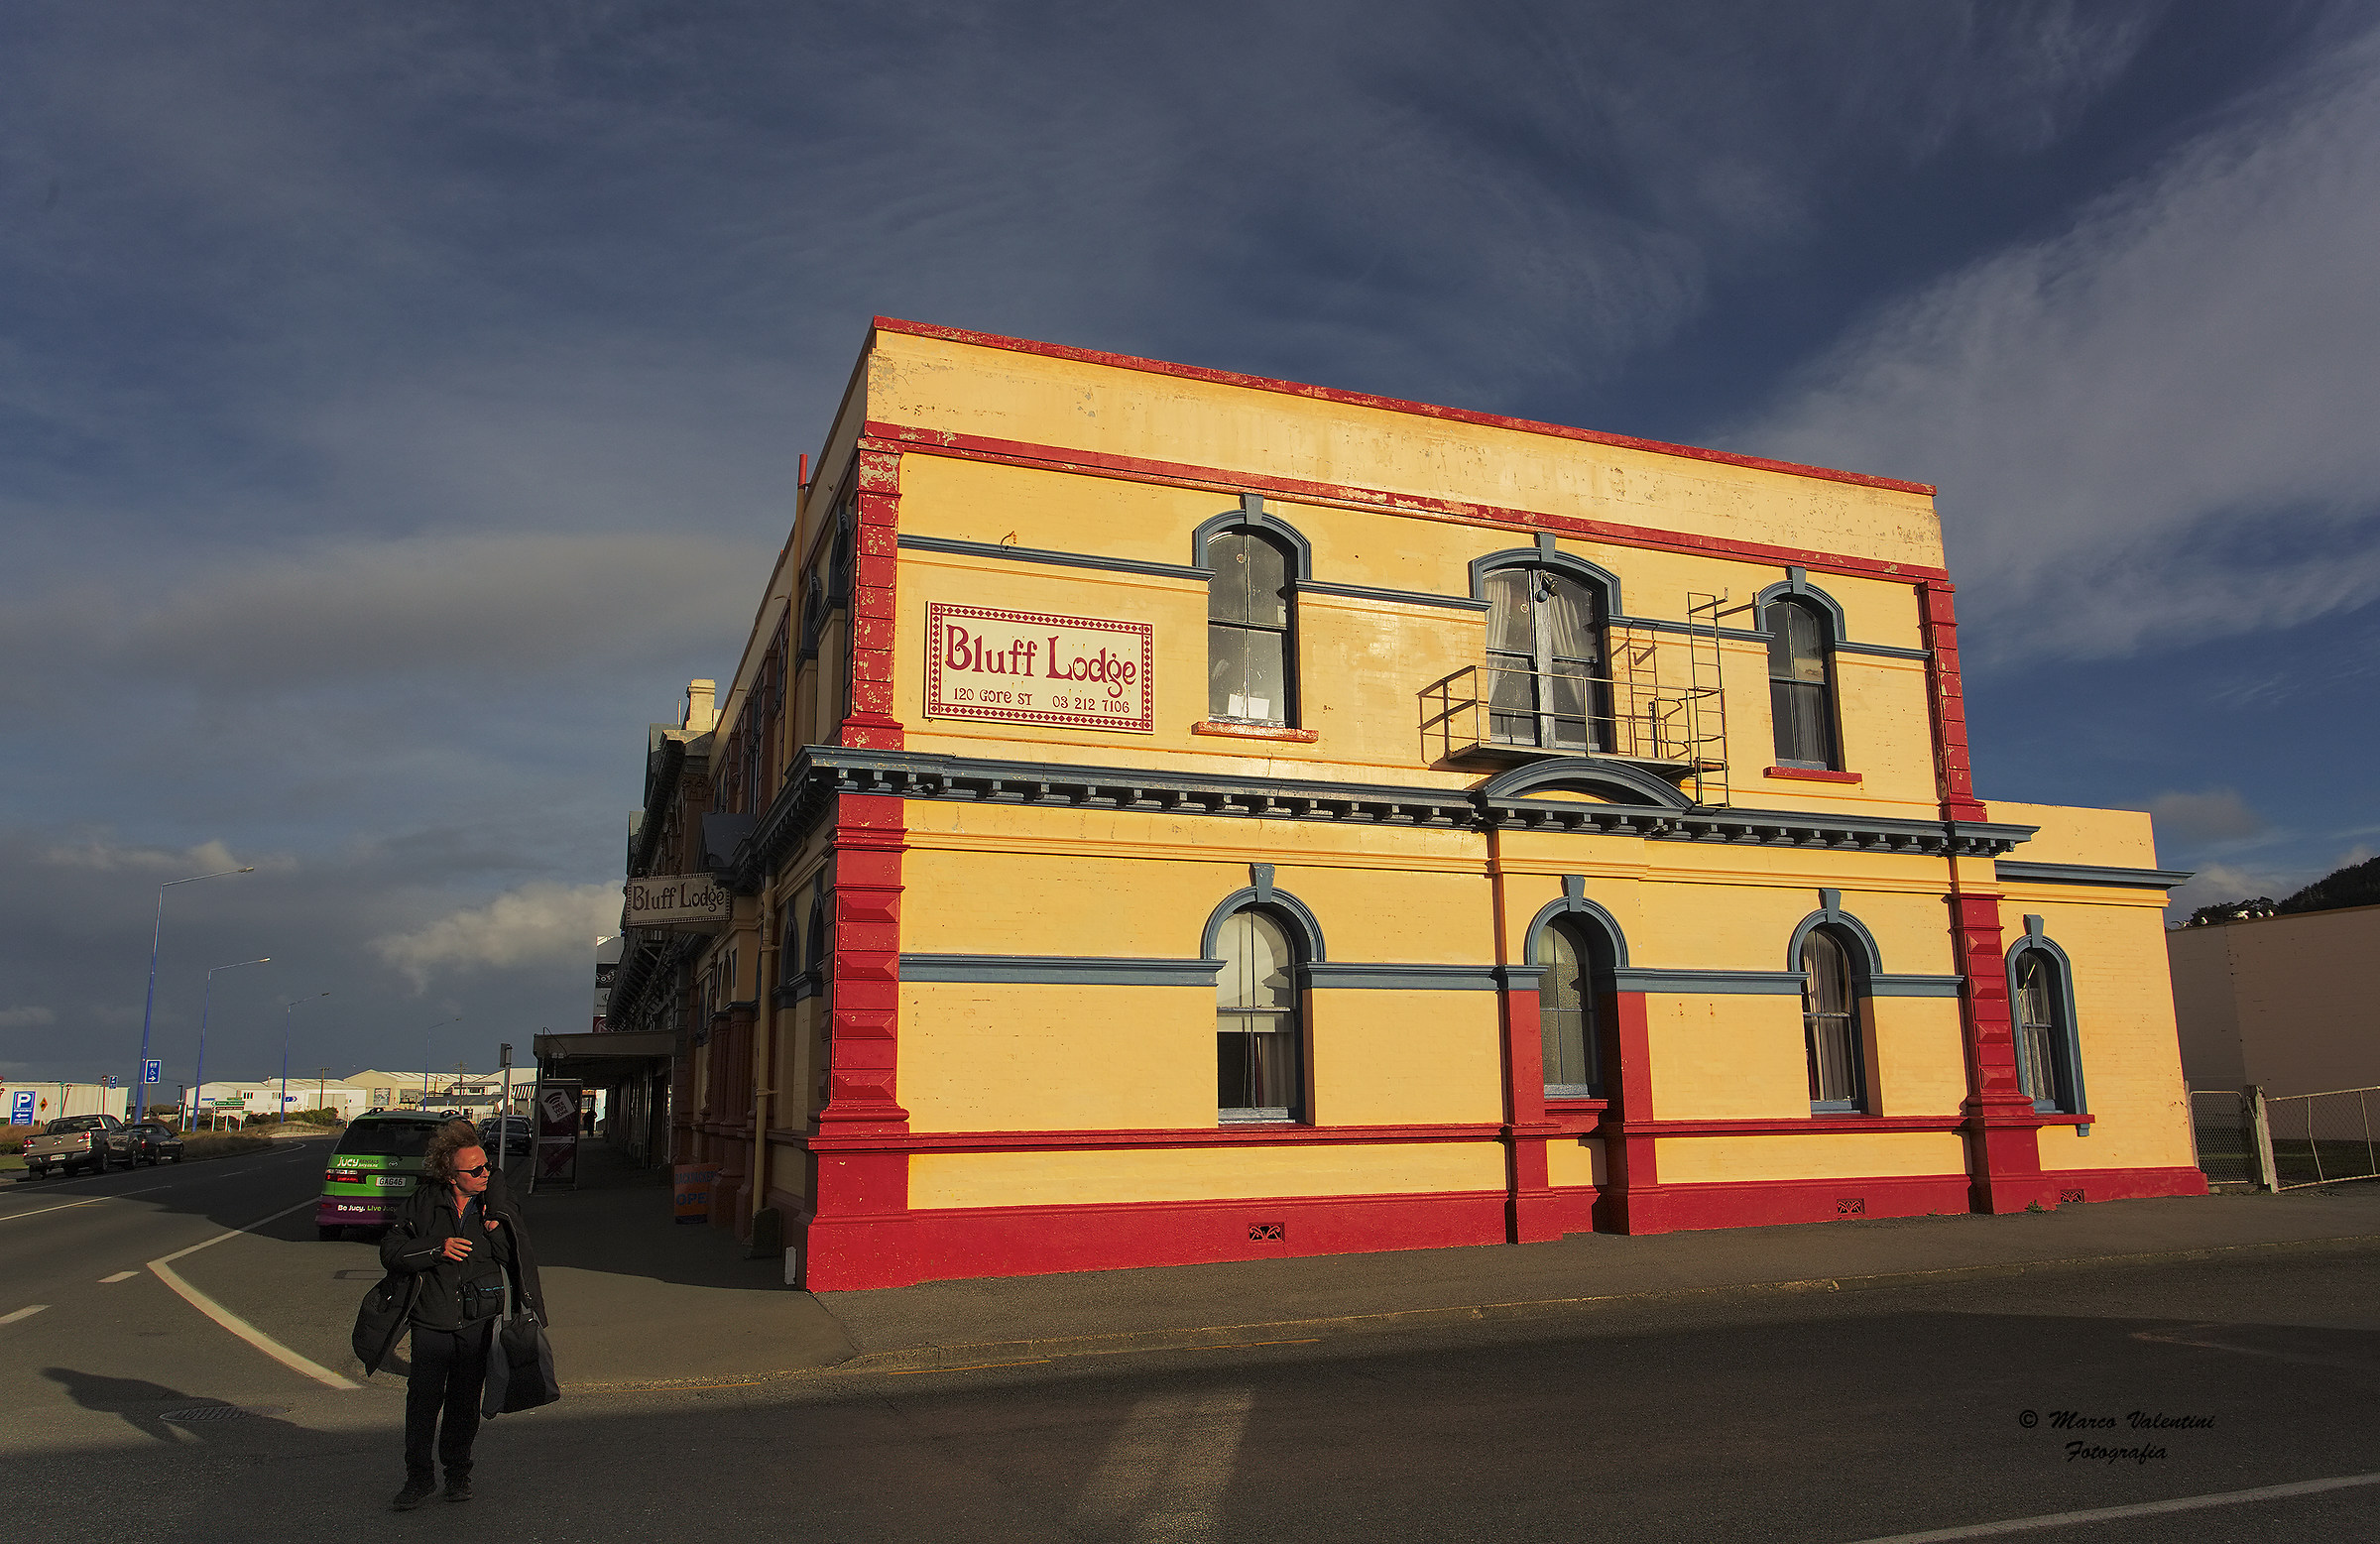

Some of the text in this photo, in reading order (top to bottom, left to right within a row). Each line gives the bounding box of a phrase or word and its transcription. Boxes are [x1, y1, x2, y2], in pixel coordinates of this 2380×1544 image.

[945, 624, 1136, 698] Bluff Lodge
[954, 687, 974, 700] 120
[1052, 695, 1130, 714] 03 212 7106
[632, 883, 725, 911] Bluff Lodge
[676, 1192, 707, 1206] OPE
